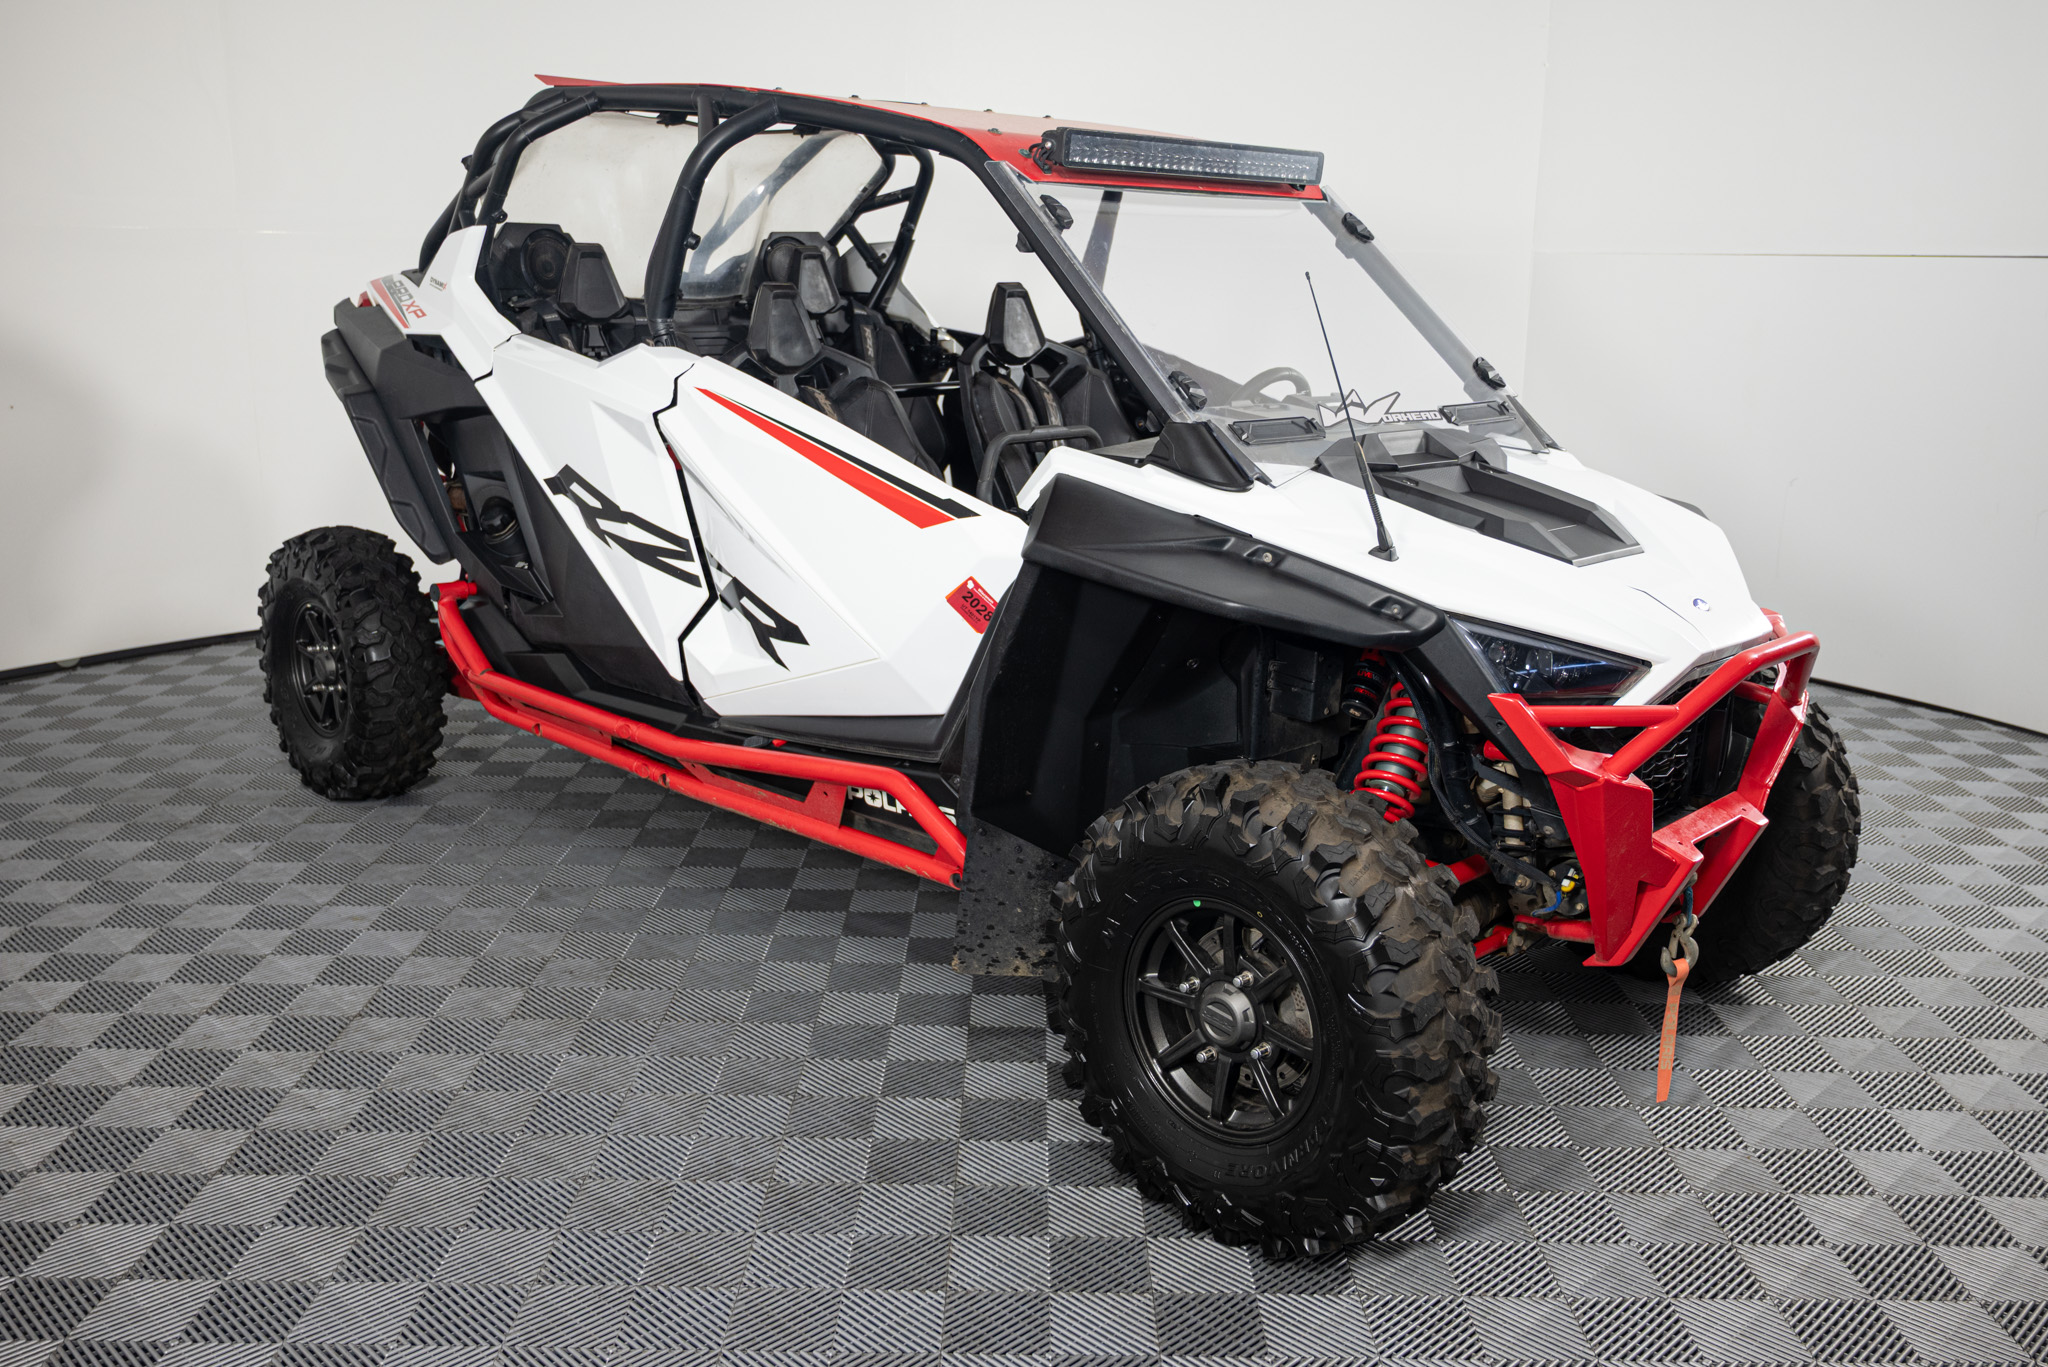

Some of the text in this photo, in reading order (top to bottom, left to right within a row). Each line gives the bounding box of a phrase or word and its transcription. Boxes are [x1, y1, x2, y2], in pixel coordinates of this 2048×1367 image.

[543, 464, 810, 672] RZR
[961, 590, 995, 622] 2028
[1660, 1002, 1678, 1071] POLARIS
